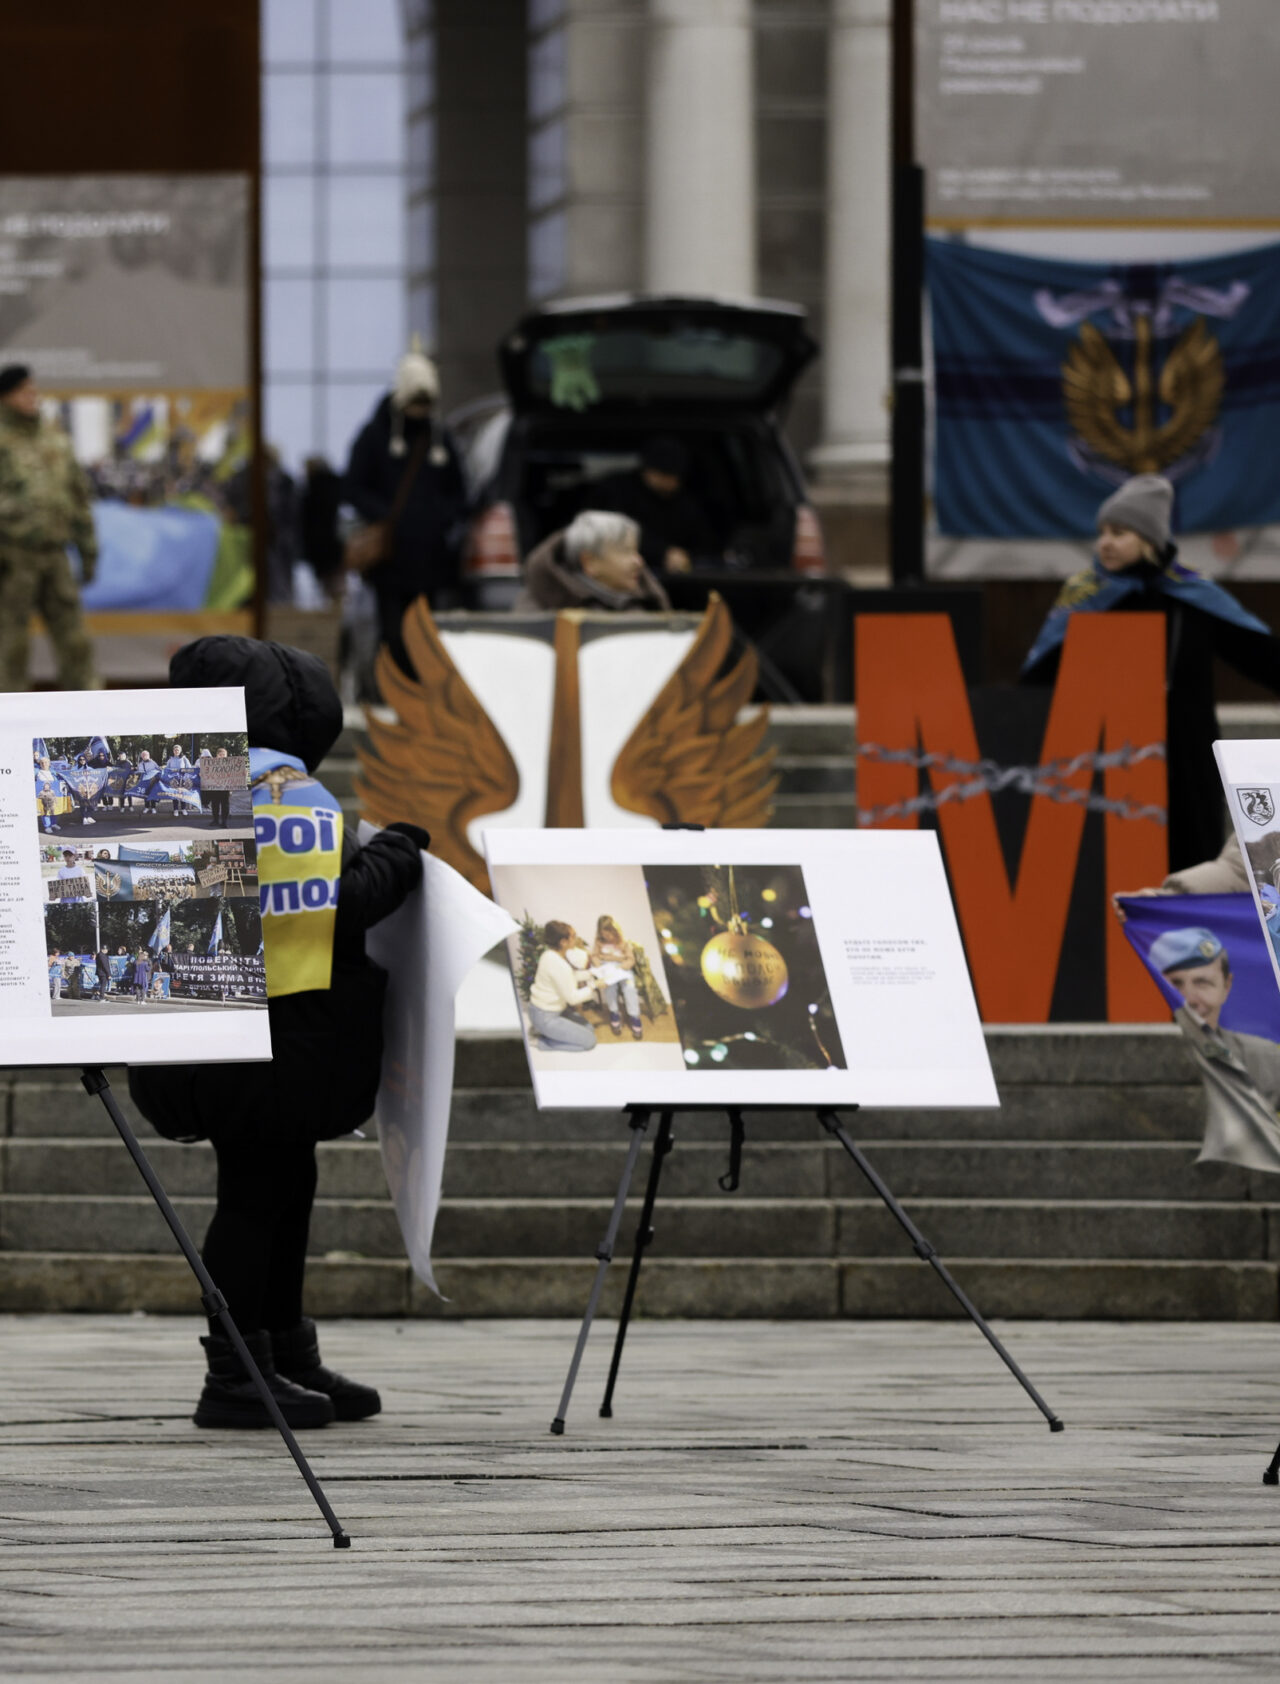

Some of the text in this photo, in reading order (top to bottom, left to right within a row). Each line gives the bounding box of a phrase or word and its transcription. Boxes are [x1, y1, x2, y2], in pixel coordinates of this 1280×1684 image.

[191, 956, 259, 965] ПОВЕРНІТЬ
[171, 973, 204, 981] ТРЕТЯ
[210, 974, 244, 982] ЗИМА
